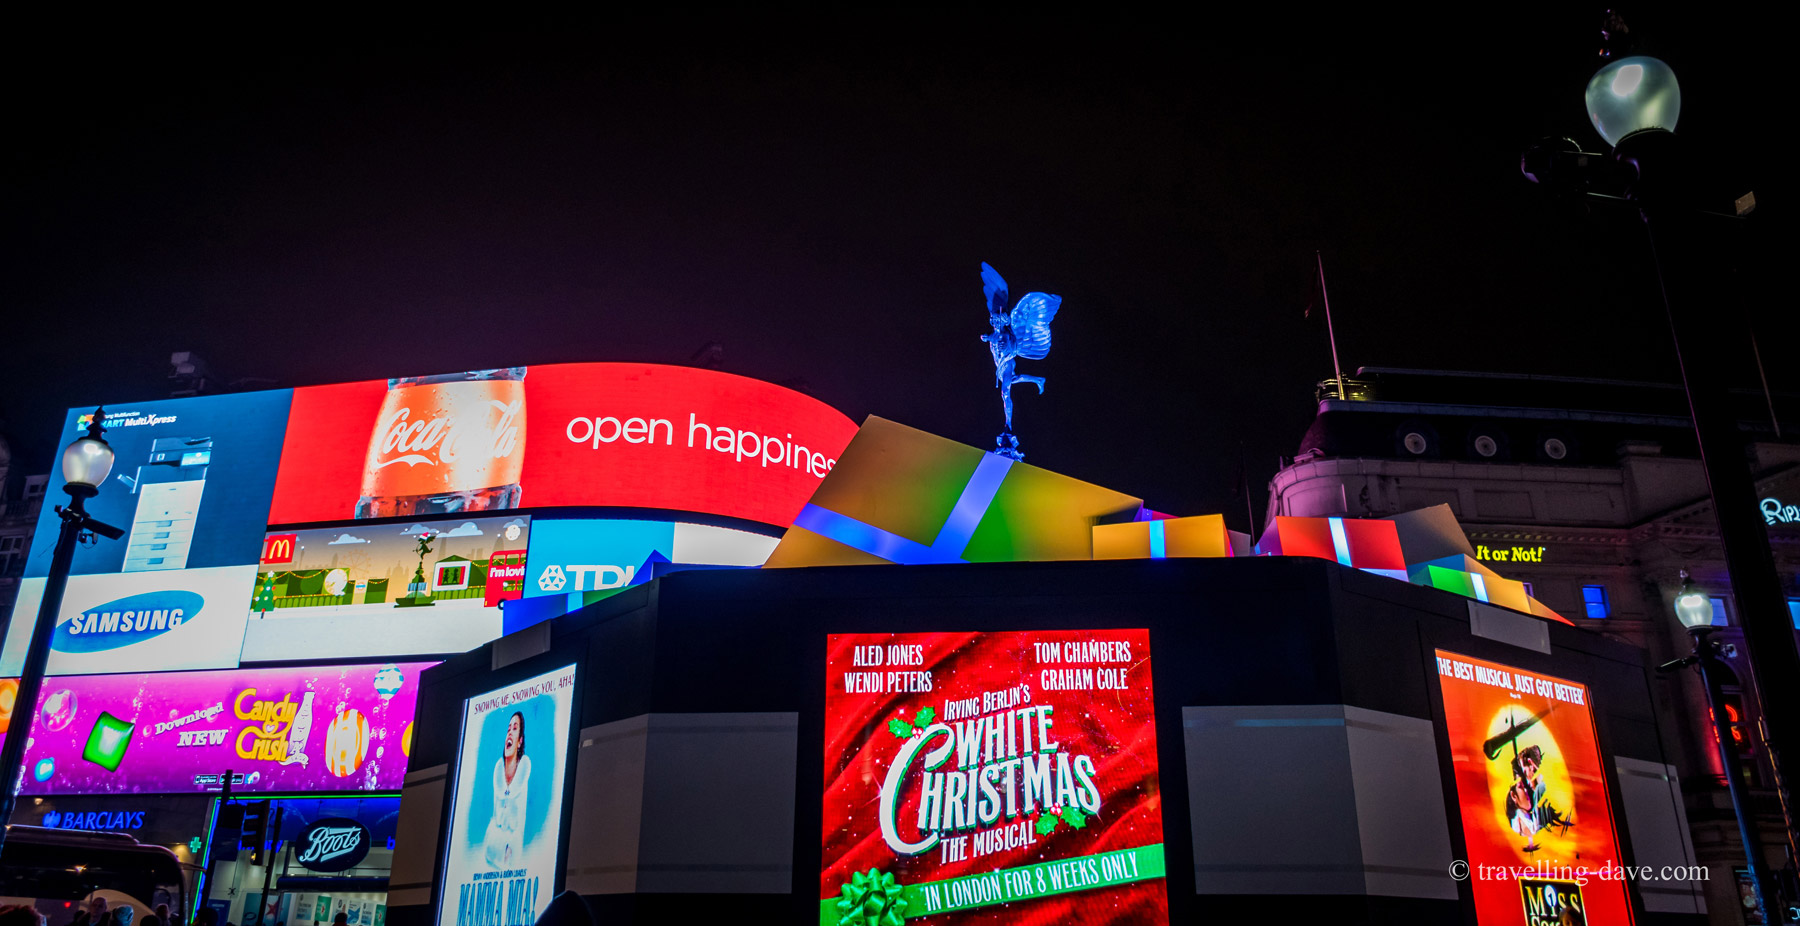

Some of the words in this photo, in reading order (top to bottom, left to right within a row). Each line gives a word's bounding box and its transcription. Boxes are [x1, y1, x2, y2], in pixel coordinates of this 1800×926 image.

[566, 416, 673, 450] open
[1760, 498, 1800, 525] RIPL
[1476, 545, 1491, 561] It
[1492, 549, 1509, 561] or
[1511, 546, 1543, 562] Not!
[489, 567, 505, 578] I'm
[68, 608, 184, 635] SAMSUNG
[853, 645, 883, 667] ALED
[886, 644, 923, 666] JONES
[1033, 642, 1060, 663] TOM
[1064, 641, 1132, 663] CHAMBERS
[844, 672, 883, 693] WENDI
[887, 671, 933, 692] PETERS
[1041, 669, 1093, 690] GRAHAM
[1096, 668, 1128, 690] COLE
[1453, 660, 1474, 681] BEST
[1475, 665, 1514, 690] MUSICAL
[1514, 674, 1535, 694] JUST
[1536, 678, 1554, 698] GOT
[234, 687, 299, 731] Candy
[474, 696, 500, 714] SNOWING
[512, 684, 540, 704] SNOWING
[943, 696, 980, 721] IRVING
[982, 684, 1031, 711] BERLIN'S
[154, 702, 224, 735] Download
[177, 729, 229, 747] NEW
[235, 726, 290, 762] Crush
[956, 704, 1060, 771] WHITE
[879, 723, 1102, 856] CHRISTMAS
[62, 811, 146, 829] BARCLAYS
[300, 826, 362, 862] Boots
[940, 836, 968, 865] THE
[973, 820, 1037, 857] MUSICAL
[924, 886, 943, 912] IN
[944, 874, 1002, 909] LONDON
[1005, 869, 1034, 899] FOR
[1036, 867, 1047, 894] 8
[1048, 857, 1099, 893] WEEKS
[1101, 851, 1140, 882] ONLY
